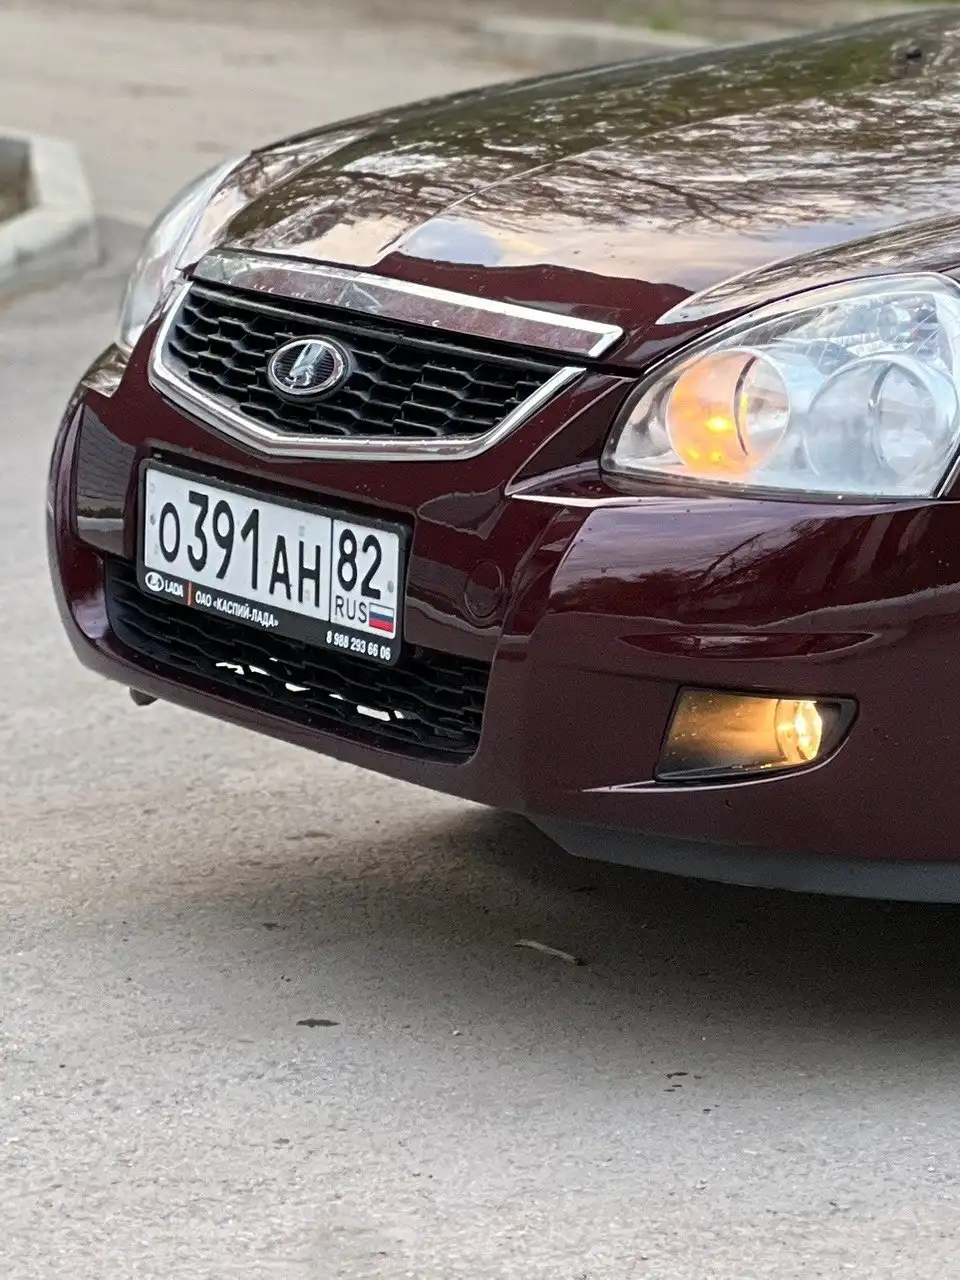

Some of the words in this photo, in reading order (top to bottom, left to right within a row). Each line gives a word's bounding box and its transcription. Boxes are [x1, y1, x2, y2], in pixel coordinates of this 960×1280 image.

[337, 528, 382, 600] 82
[164, 580, 184, 597] LADA
[335, 595, 367, 623] RUS
[326, 631, 332, 644] 8
[350, 638, 366, 654] 293
[380, 646, 391, 661] 06
